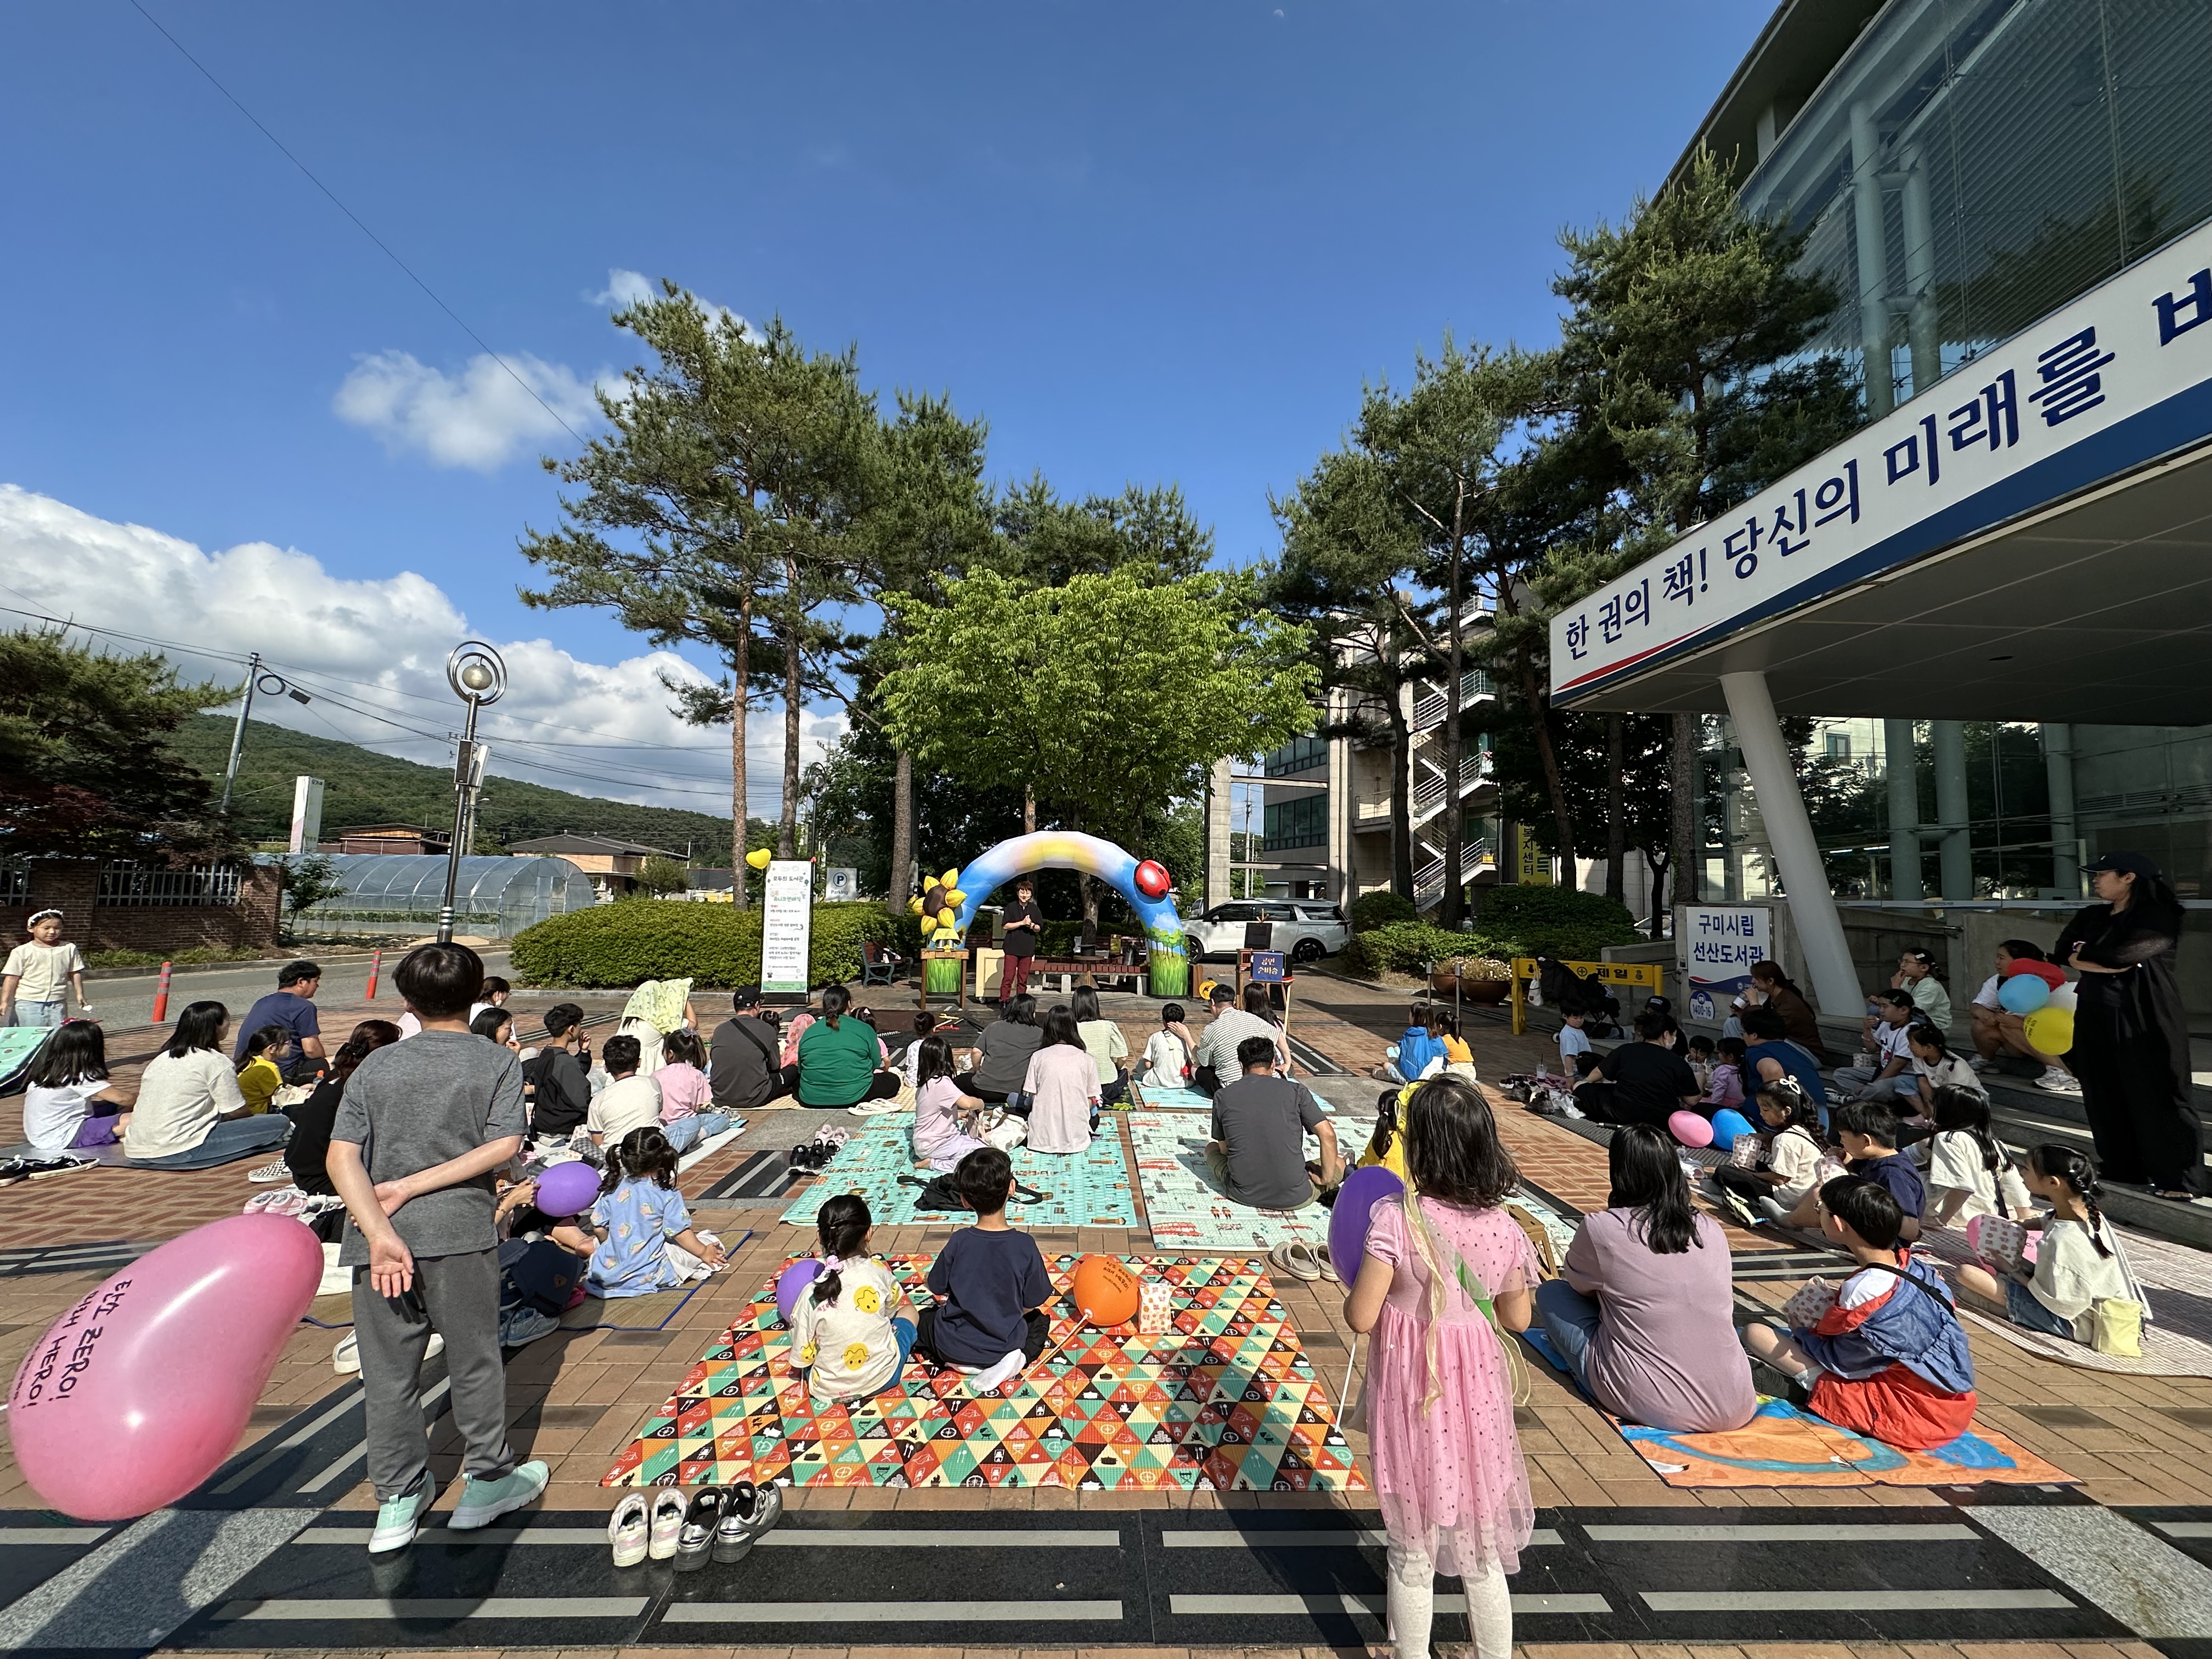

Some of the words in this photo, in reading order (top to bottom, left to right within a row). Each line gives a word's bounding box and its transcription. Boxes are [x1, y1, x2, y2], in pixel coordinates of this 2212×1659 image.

[1566, 613, 1589, 660] 한
[1598, 579, 1650, 645] 권의
[1662, 553, 1707, 606] 책!
[1723, 459, 1860, 580] 당신의
[1883, 326, 2115, 487] 미래를
[837, 876, 844, 884] P
[1699, 914, 1754, 936] 구미시립
[1694, 941, 1764, 967] 선산도서관
[1596, 967, 1628, 979] 제일
[1692, 1004, 1711, 1017] 1400-16
[21, 1335, 67, 1409] HERO!
[48, 1325, 103, 1403] ZERO!
